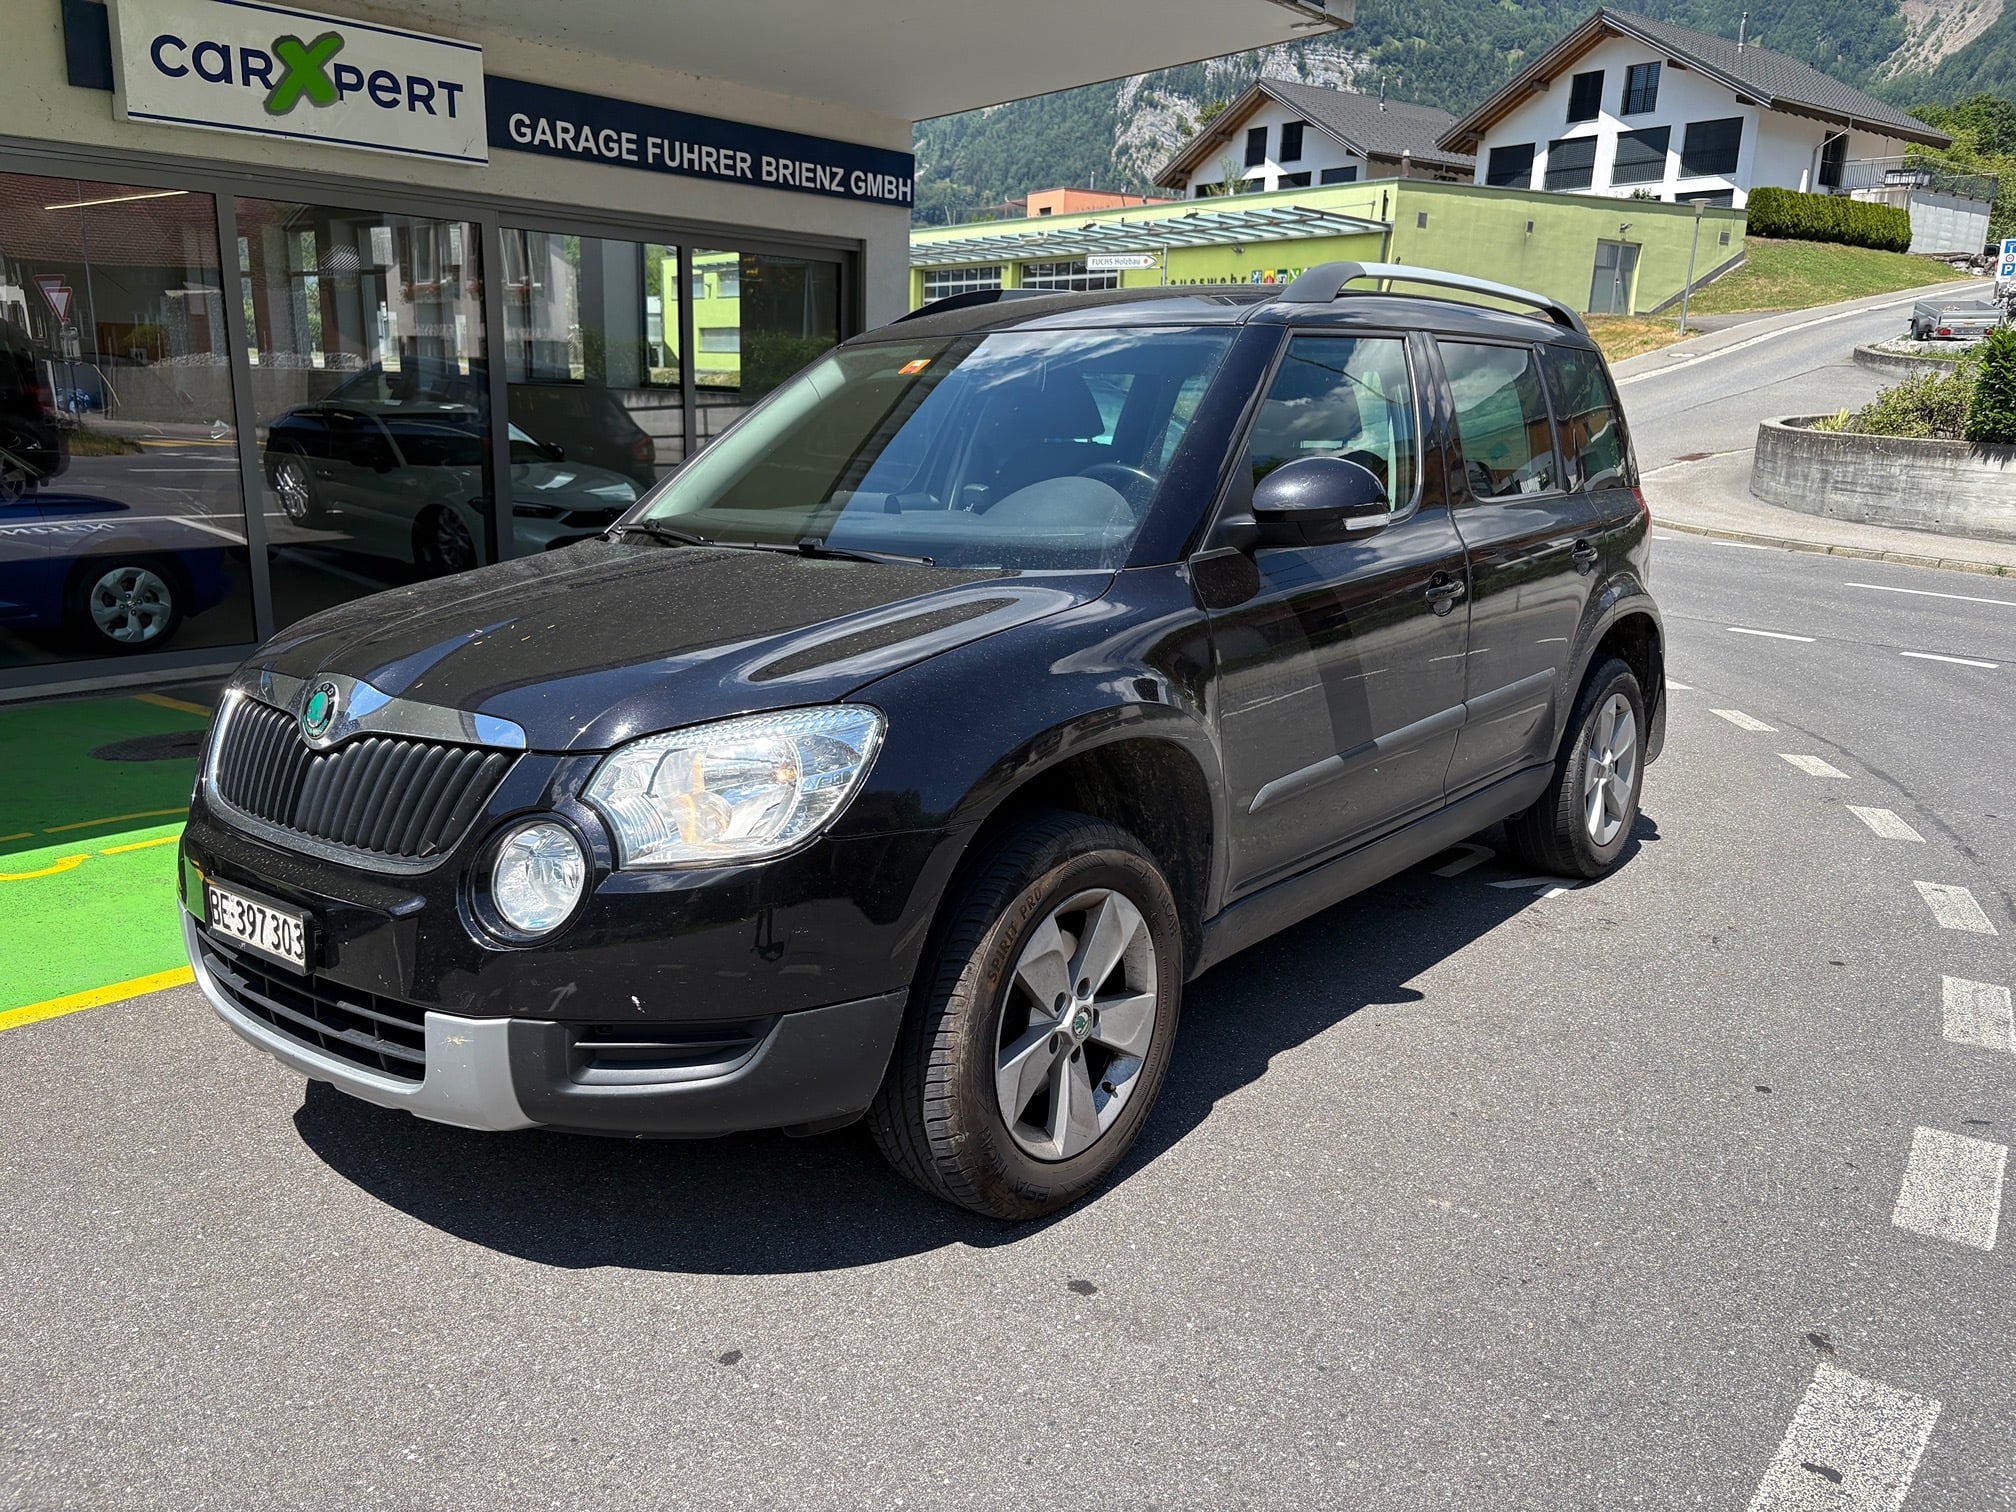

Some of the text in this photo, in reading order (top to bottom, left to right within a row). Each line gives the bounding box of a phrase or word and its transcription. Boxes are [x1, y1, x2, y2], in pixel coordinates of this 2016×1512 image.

[509, 113, 911, 202] GARAGE FUHRER BRIENZ GMBH
[1091, 257, 1141, 266] FUCHS Holzbau
[270, 913, 305, 961] 303
[987, 886, 1043, 984] SPIRIT PRO
